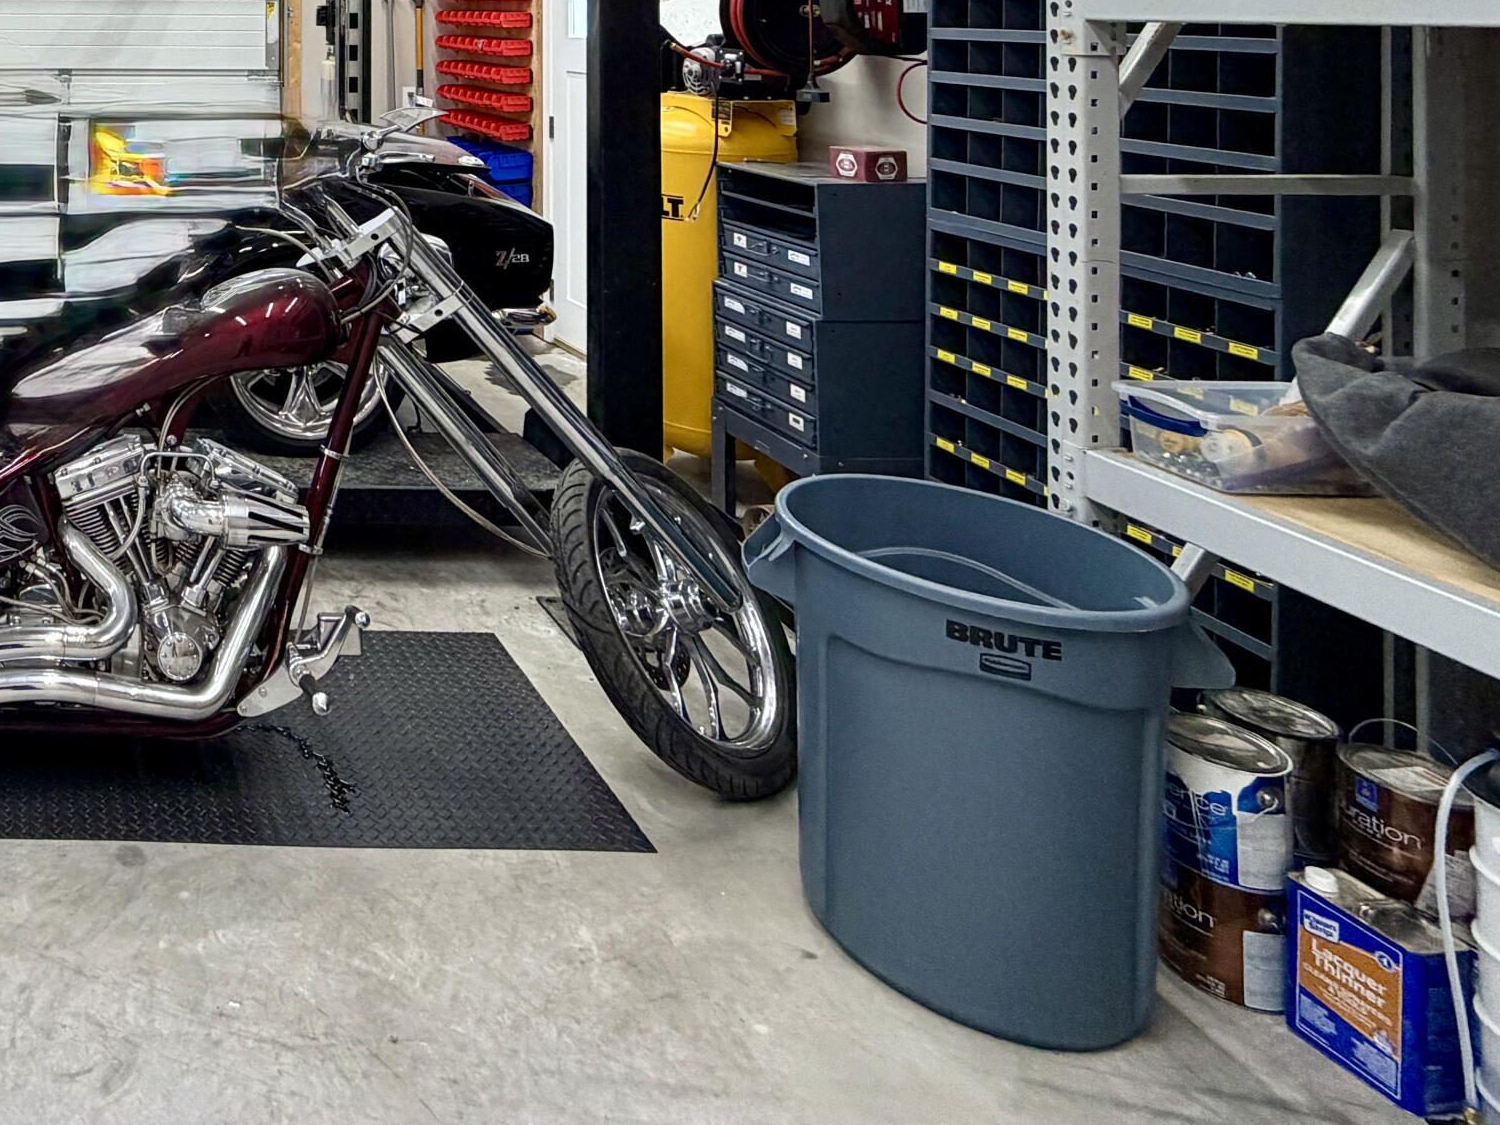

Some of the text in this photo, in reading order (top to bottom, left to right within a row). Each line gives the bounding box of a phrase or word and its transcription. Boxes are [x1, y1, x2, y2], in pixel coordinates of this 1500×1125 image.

[946, 619, 1062, 661] BRUTE
[1311, 937, 1387, 995] Lacquer
[1311, 950, 1387, 1009] Thinner
